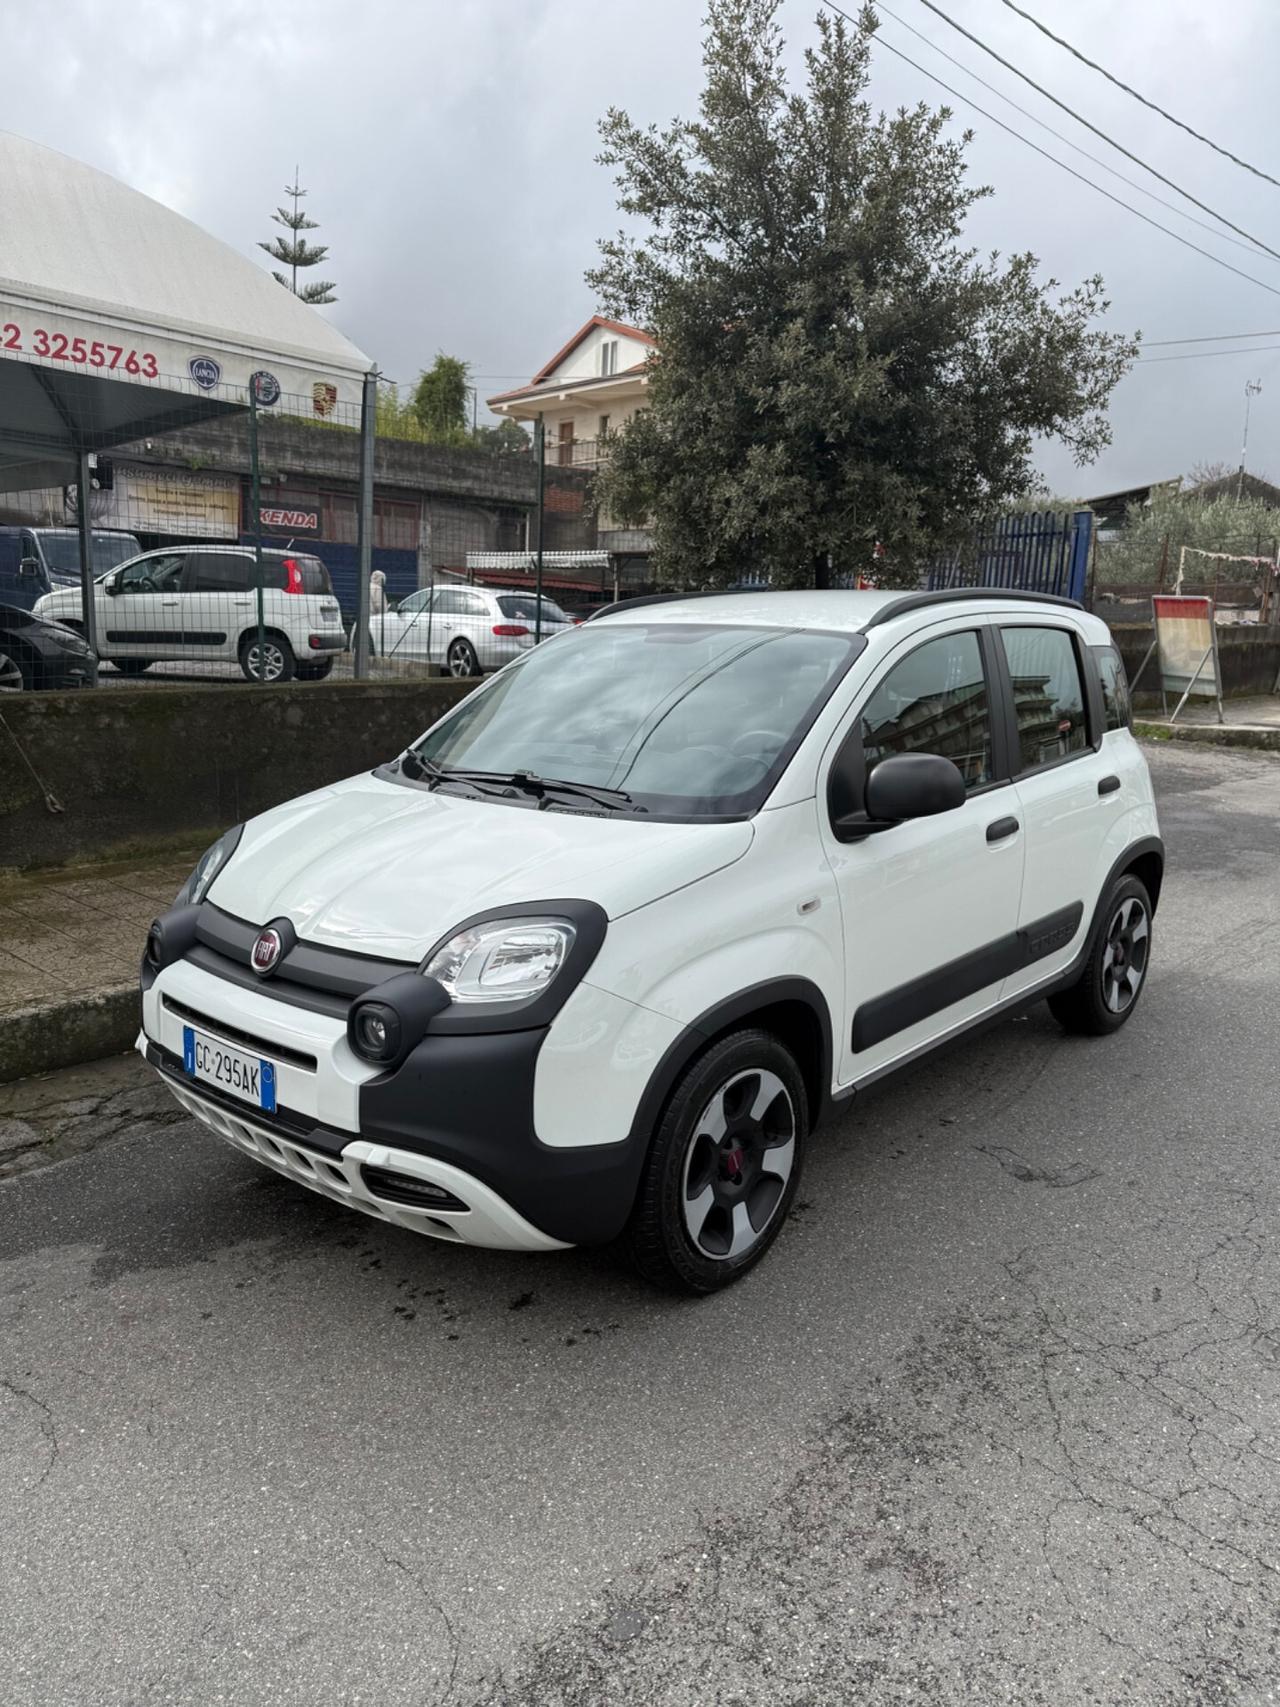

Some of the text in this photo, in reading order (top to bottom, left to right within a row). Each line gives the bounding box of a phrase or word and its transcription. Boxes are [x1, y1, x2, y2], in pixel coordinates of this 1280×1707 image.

[0, 323, 158, 378] 2 3255763
[260, 508, 317, 528] KENDA
